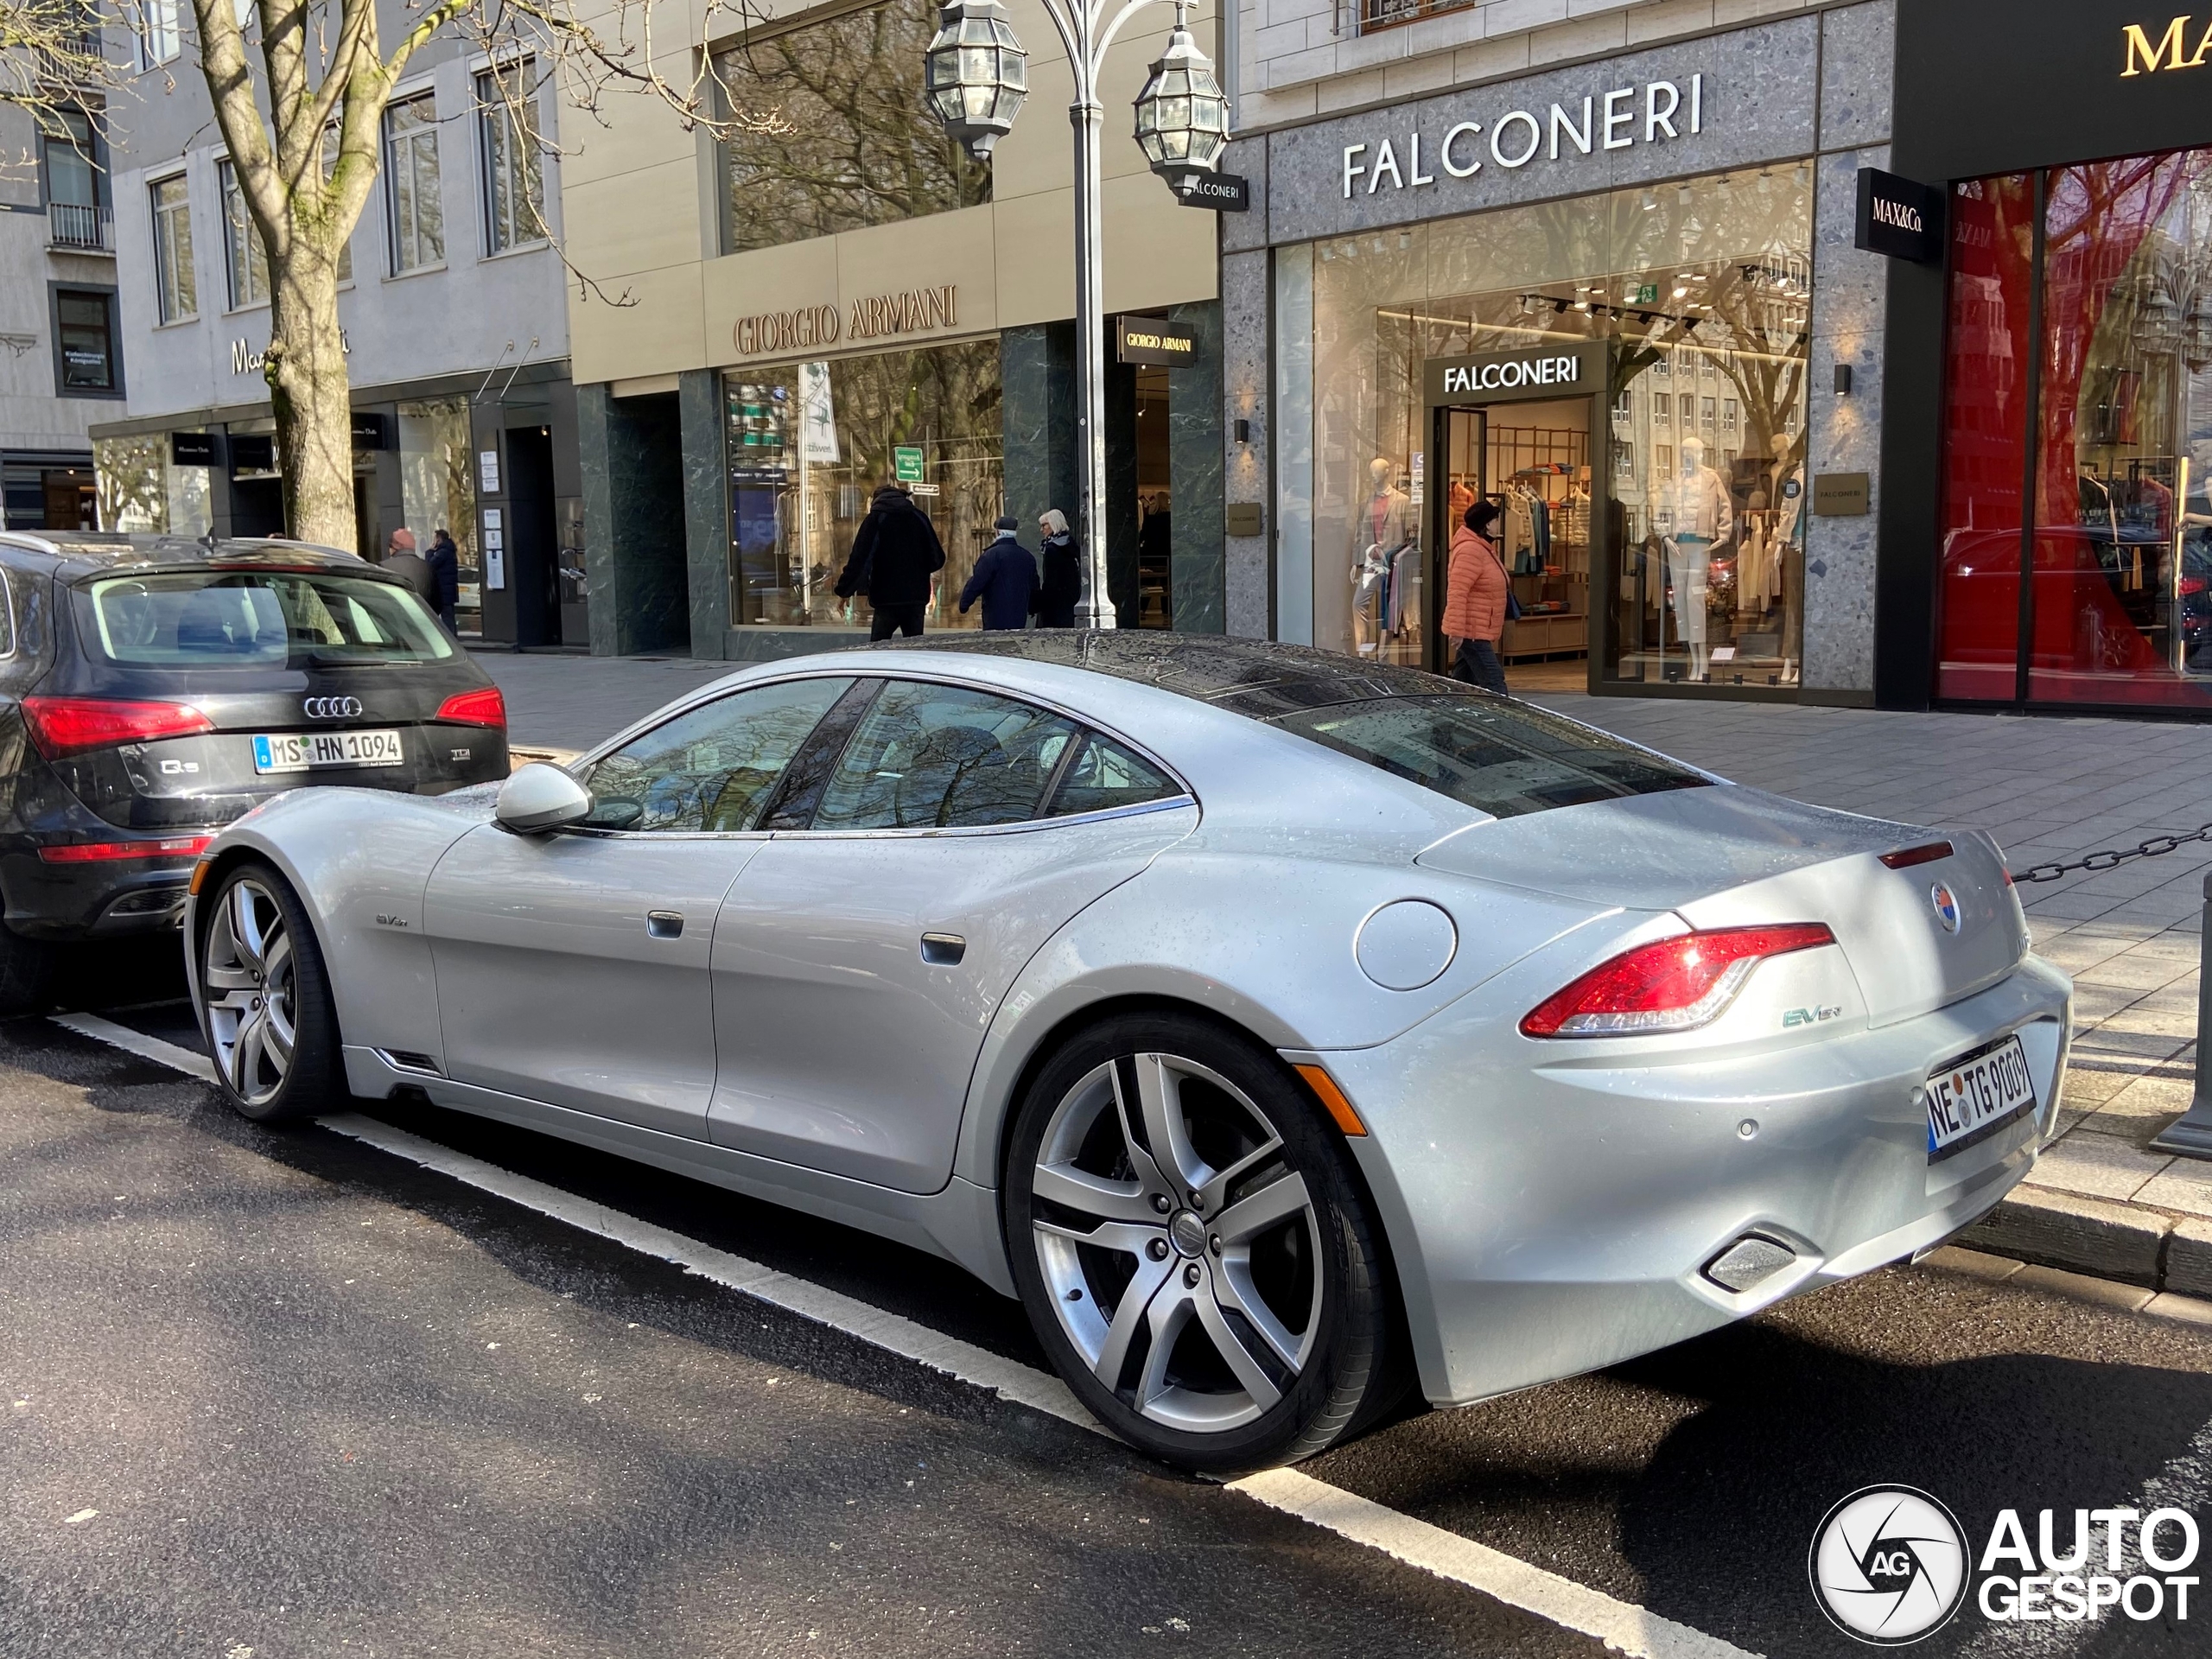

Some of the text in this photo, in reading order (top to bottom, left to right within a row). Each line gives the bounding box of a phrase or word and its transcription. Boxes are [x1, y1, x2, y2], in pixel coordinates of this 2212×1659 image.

[1344, 73, 1702, 200] FALCONERI
[1192, 182, 1239, 199] ALCONERI
[1872, 196, 1923, 232] MAX&Co.
[734, 283, 957, 355] GIORGIO ARMANI
[1127, 333, 1191, 352] GIORGIO ARMANI
[1444, 355, 1578, 393] FALCONERI
[1820, 490, 1861, 499] FALCONERI
[271, 734, 398, 764] MS HN 1094
[1926, 1081, 1961, 1139] NE
[1963, 1065, 1994, 1119] TG
[1989, 1047, 2027, 1109] 9009
